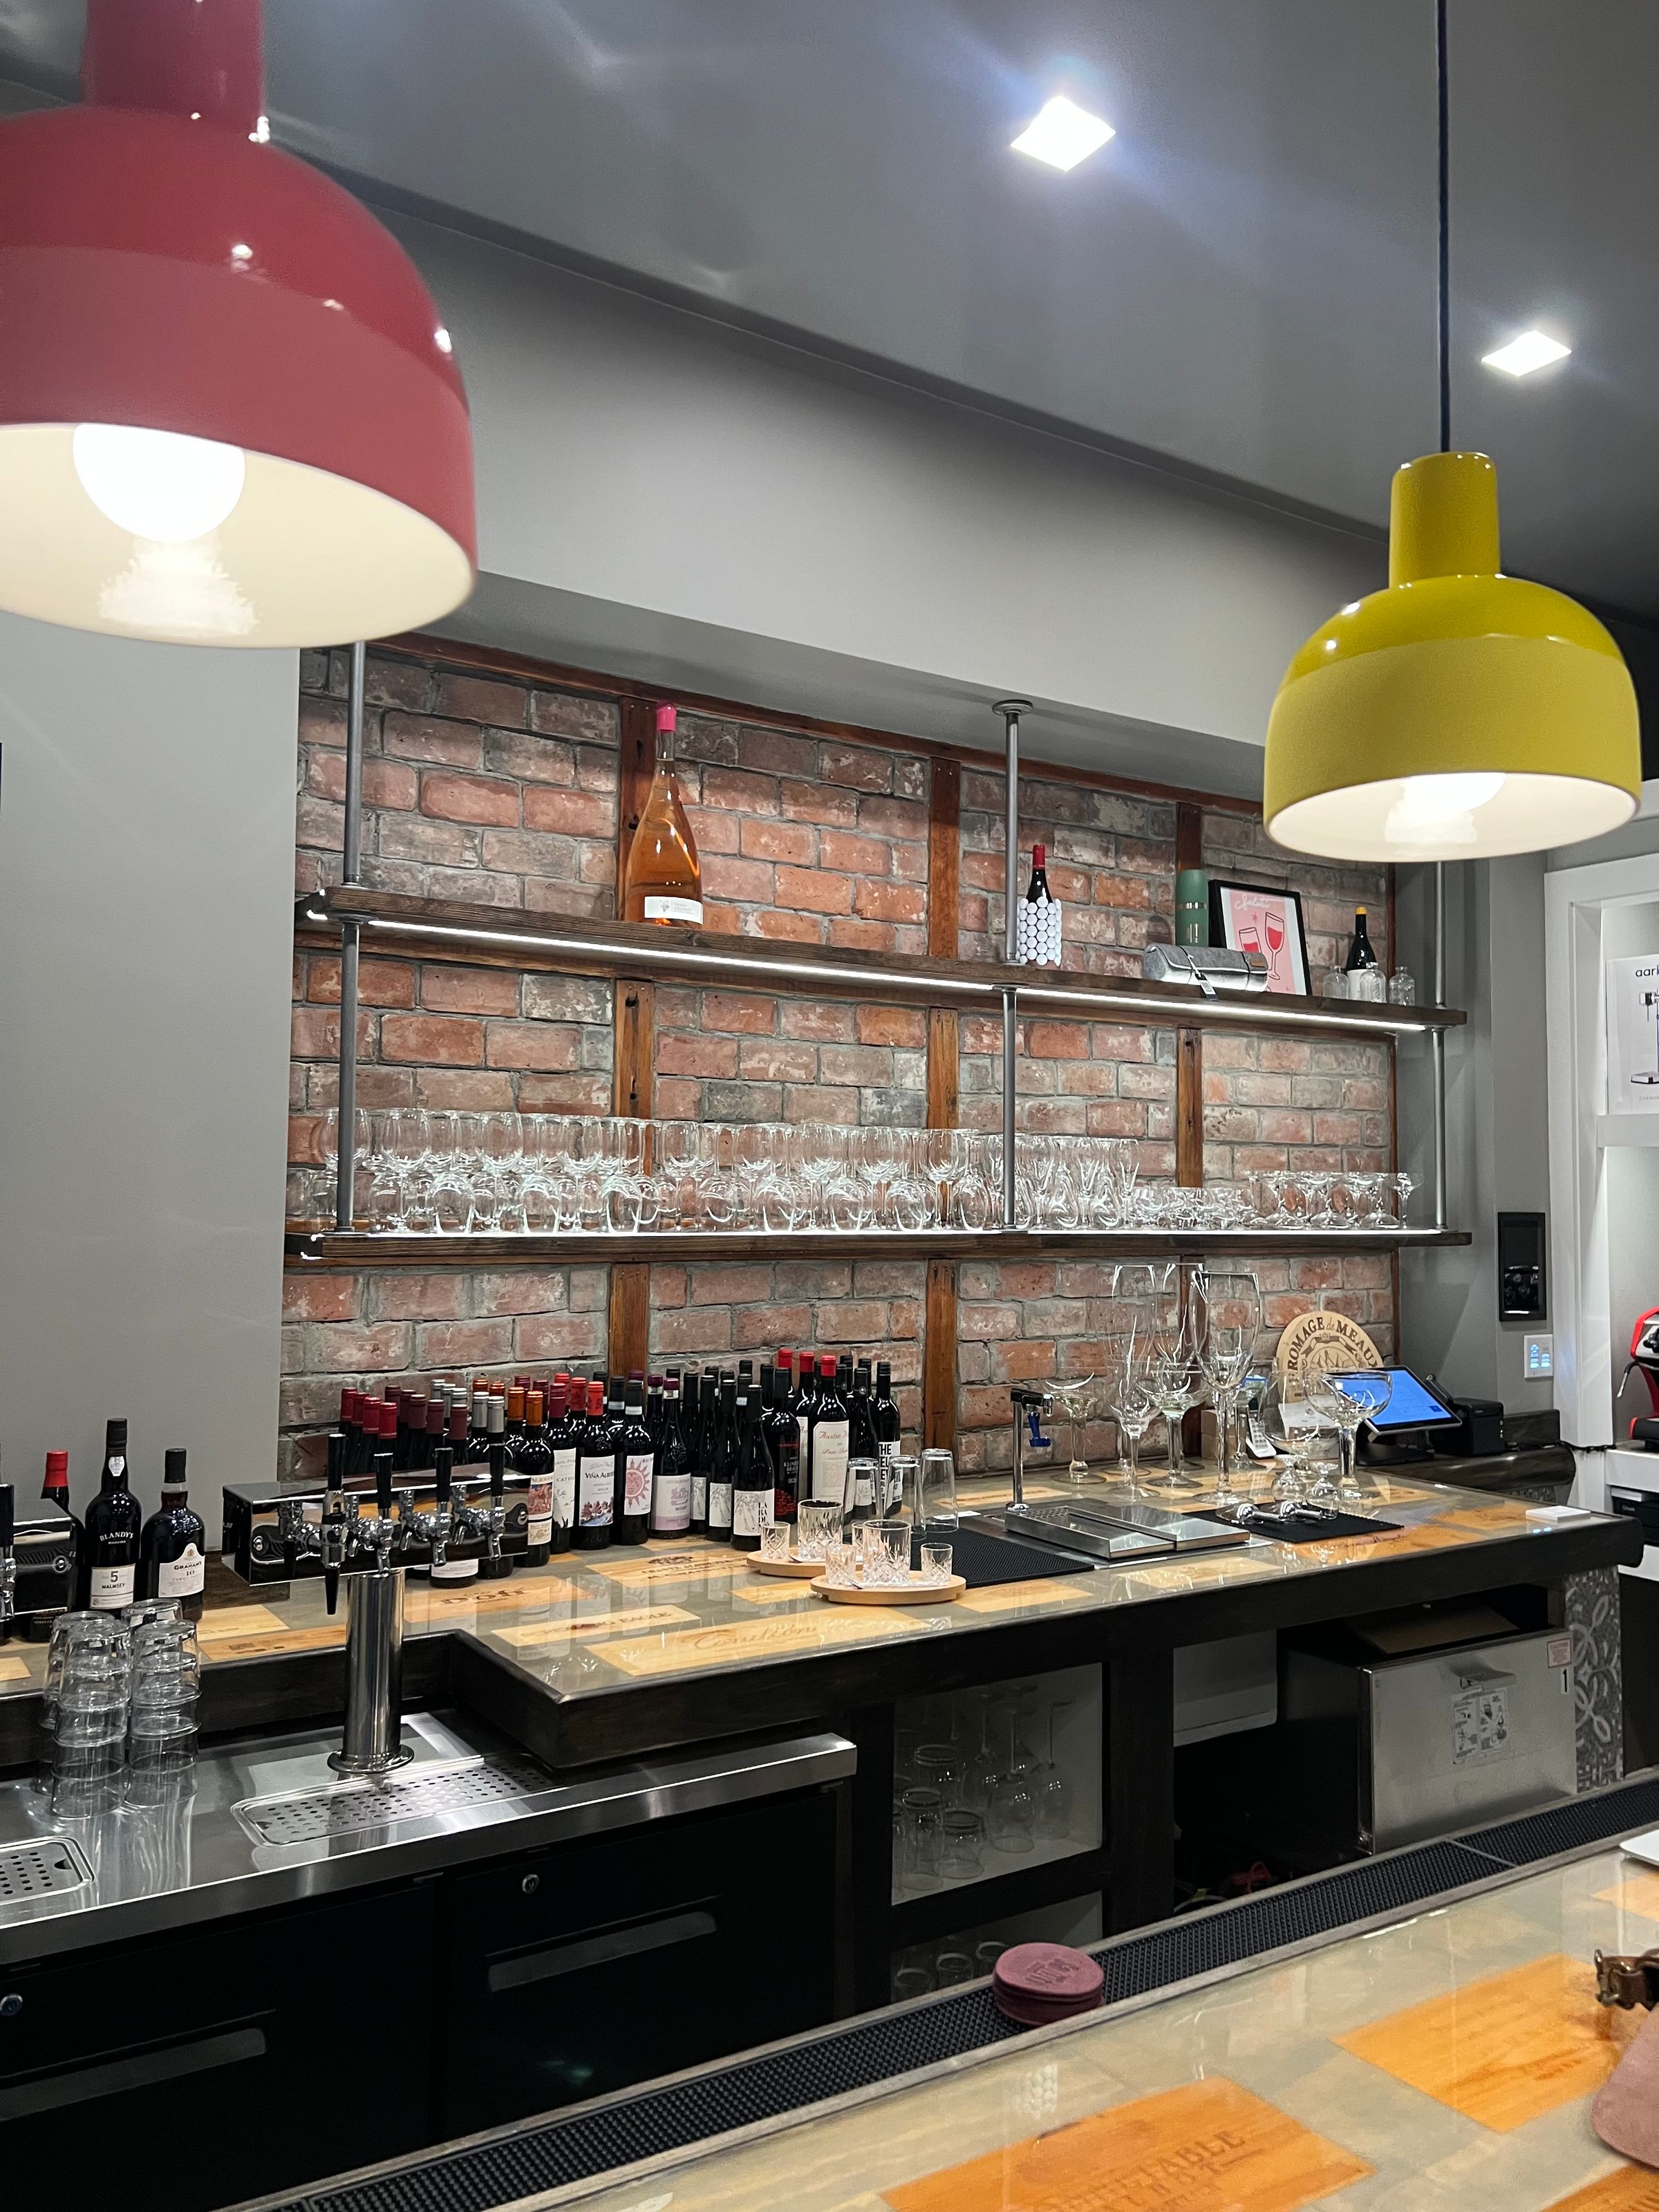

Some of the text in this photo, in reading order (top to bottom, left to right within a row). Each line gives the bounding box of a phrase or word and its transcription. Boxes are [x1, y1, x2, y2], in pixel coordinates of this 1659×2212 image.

[1326, 1317, 1335, 1331] de
[818, 1431, 841, 1439] Austin
[879, 1443, 892, 1454] HE
[100, 1530, 134, 1541] BLANDY'S
[111, 1571, 118, 1582] 5
